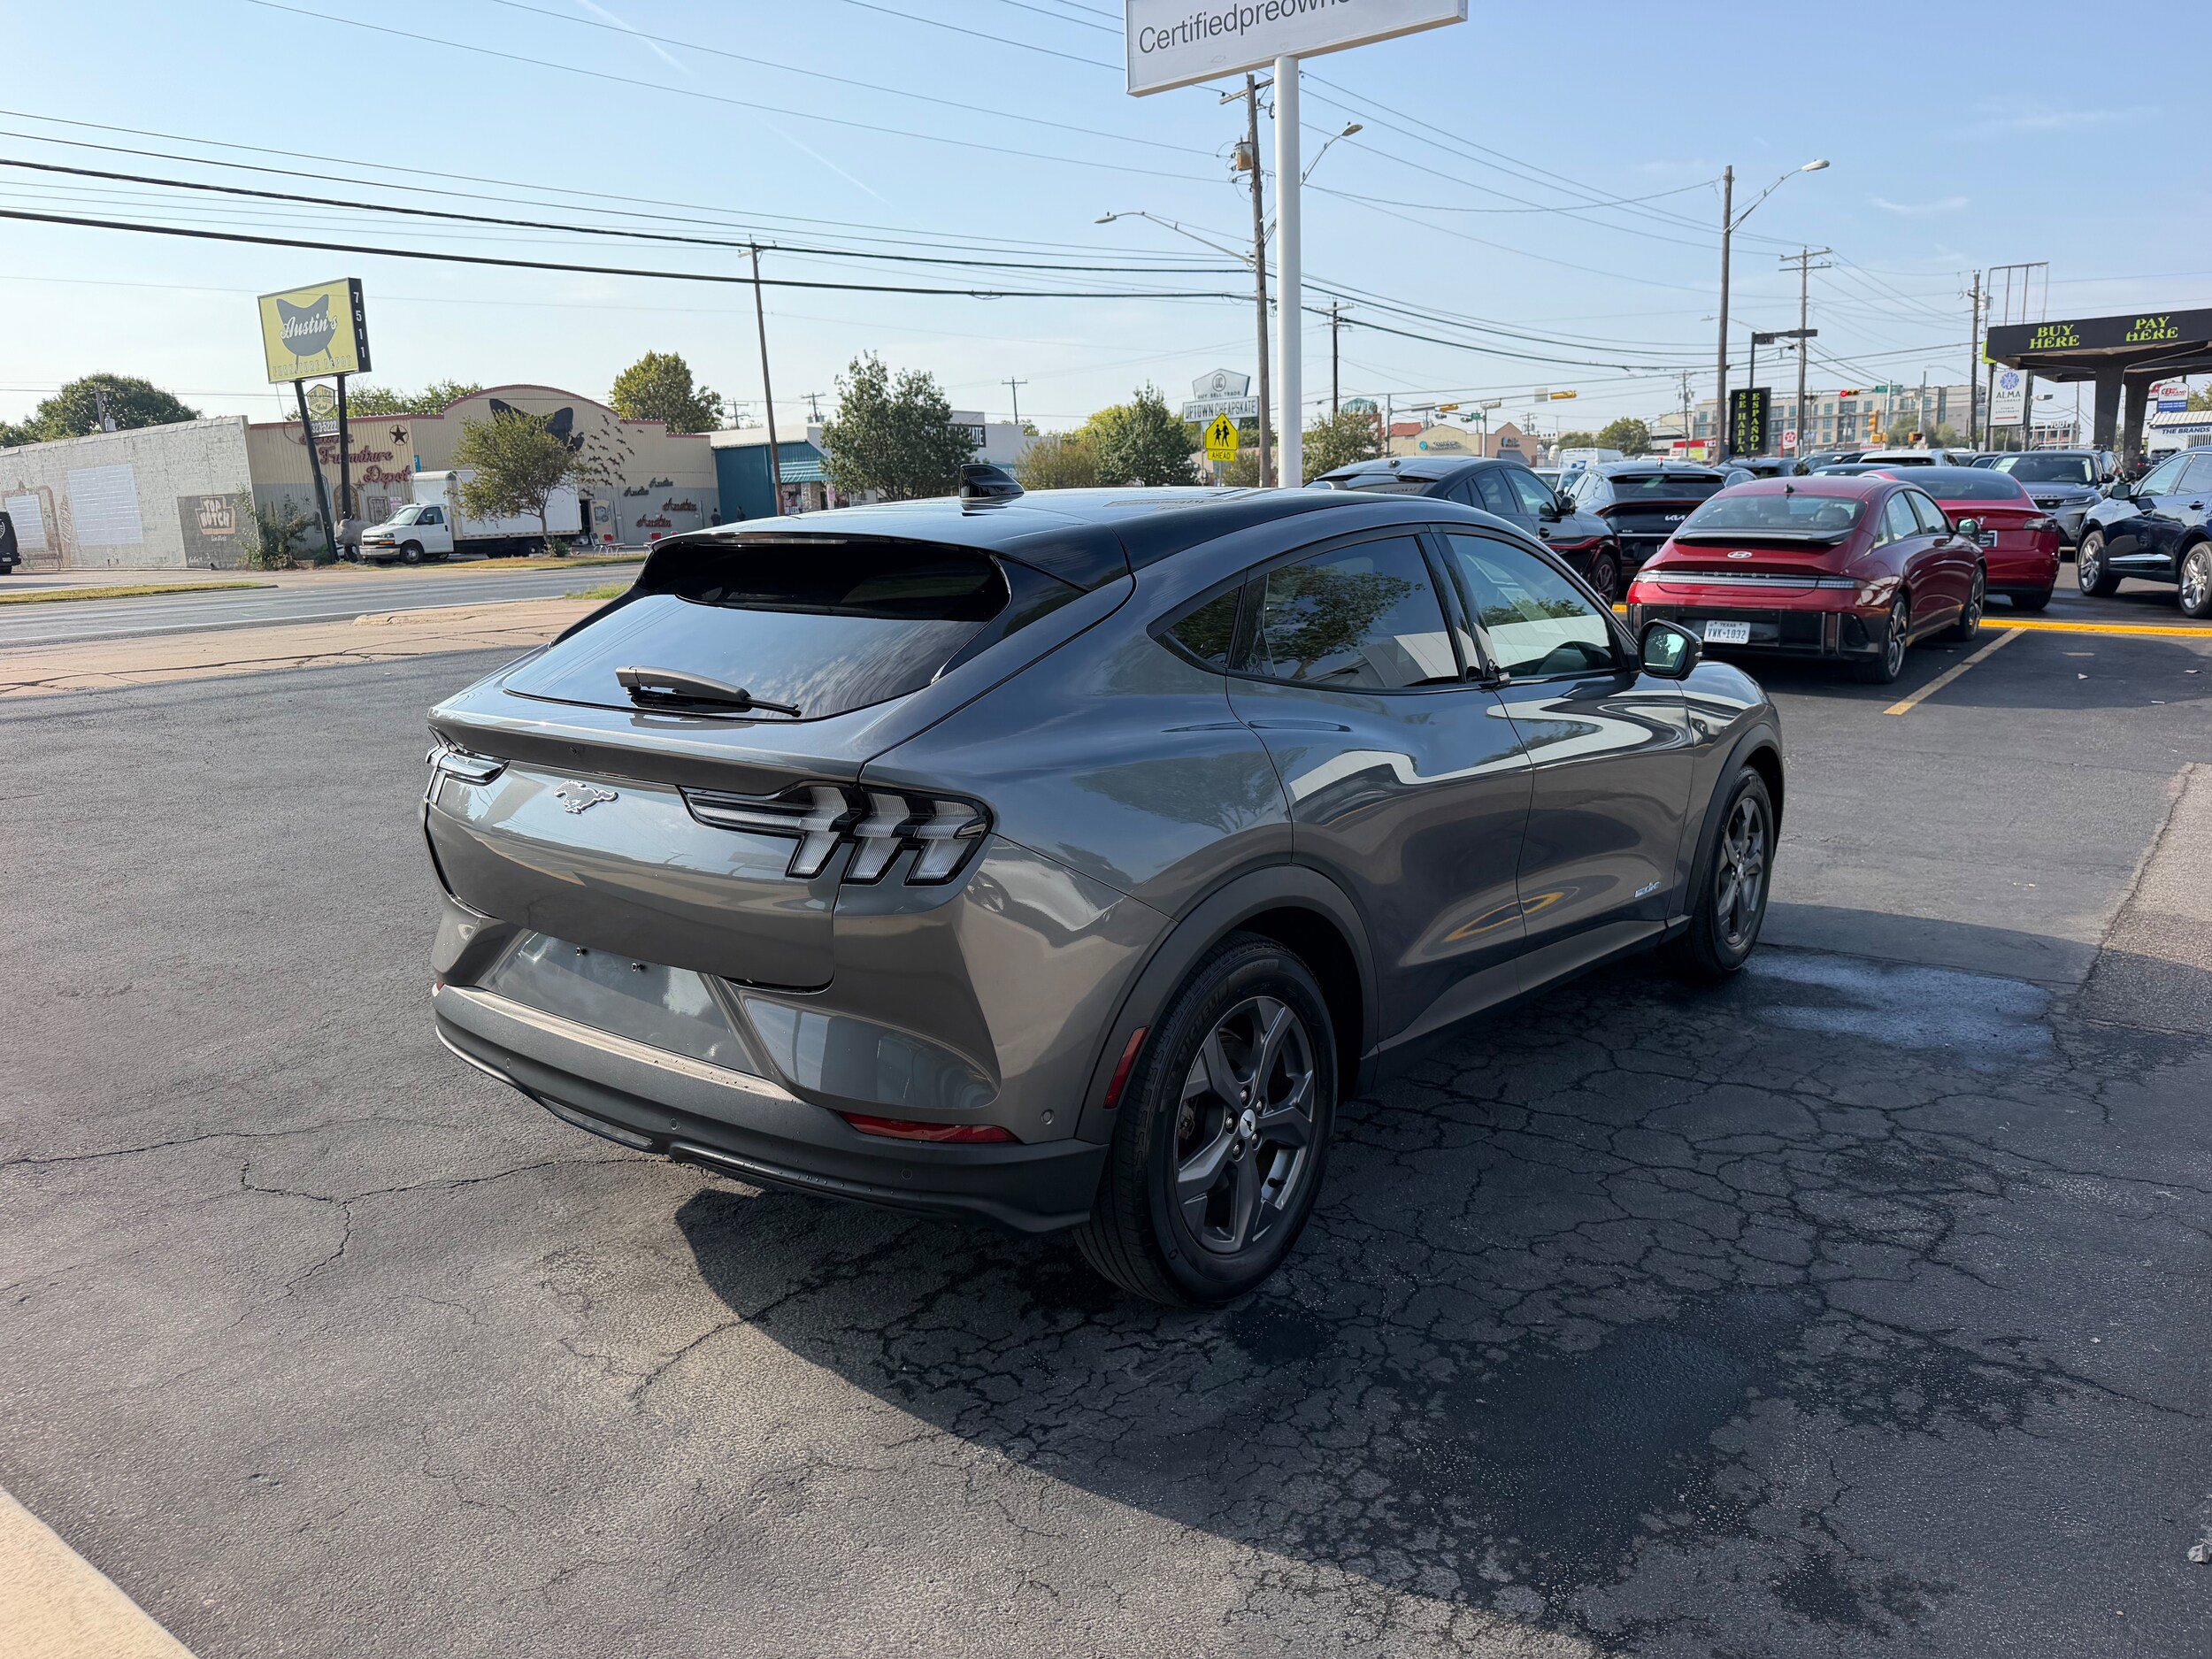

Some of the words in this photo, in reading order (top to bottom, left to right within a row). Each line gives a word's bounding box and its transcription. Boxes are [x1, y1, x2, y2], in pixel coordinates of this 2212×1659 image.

[280, 310, 338, 339] Austin's
[354, 292, 365, 358] 7511
[2037, 325, 2074, 338] BUY
[2134, 316, 2170, 330] PAY
[2029, 334, 2079, 349] HERE
[2125, 326, 2178, 342] HERE
[273, 358, 320, 377] FURNITURE
[323, 355, 352, 370] DEPOT
[1739, 392, 1746, 409] SE
[1186, 404, 1214, 419] UPTOWN
[1215, 400, 1256, 416] CHEAPSKATE
[1737, 412, 1746, 452] HABLA
[363, 465, 411, 489] Depot
[203, 499, 221, 512] TOP
[200, 511, 229, 526] NOTCH
